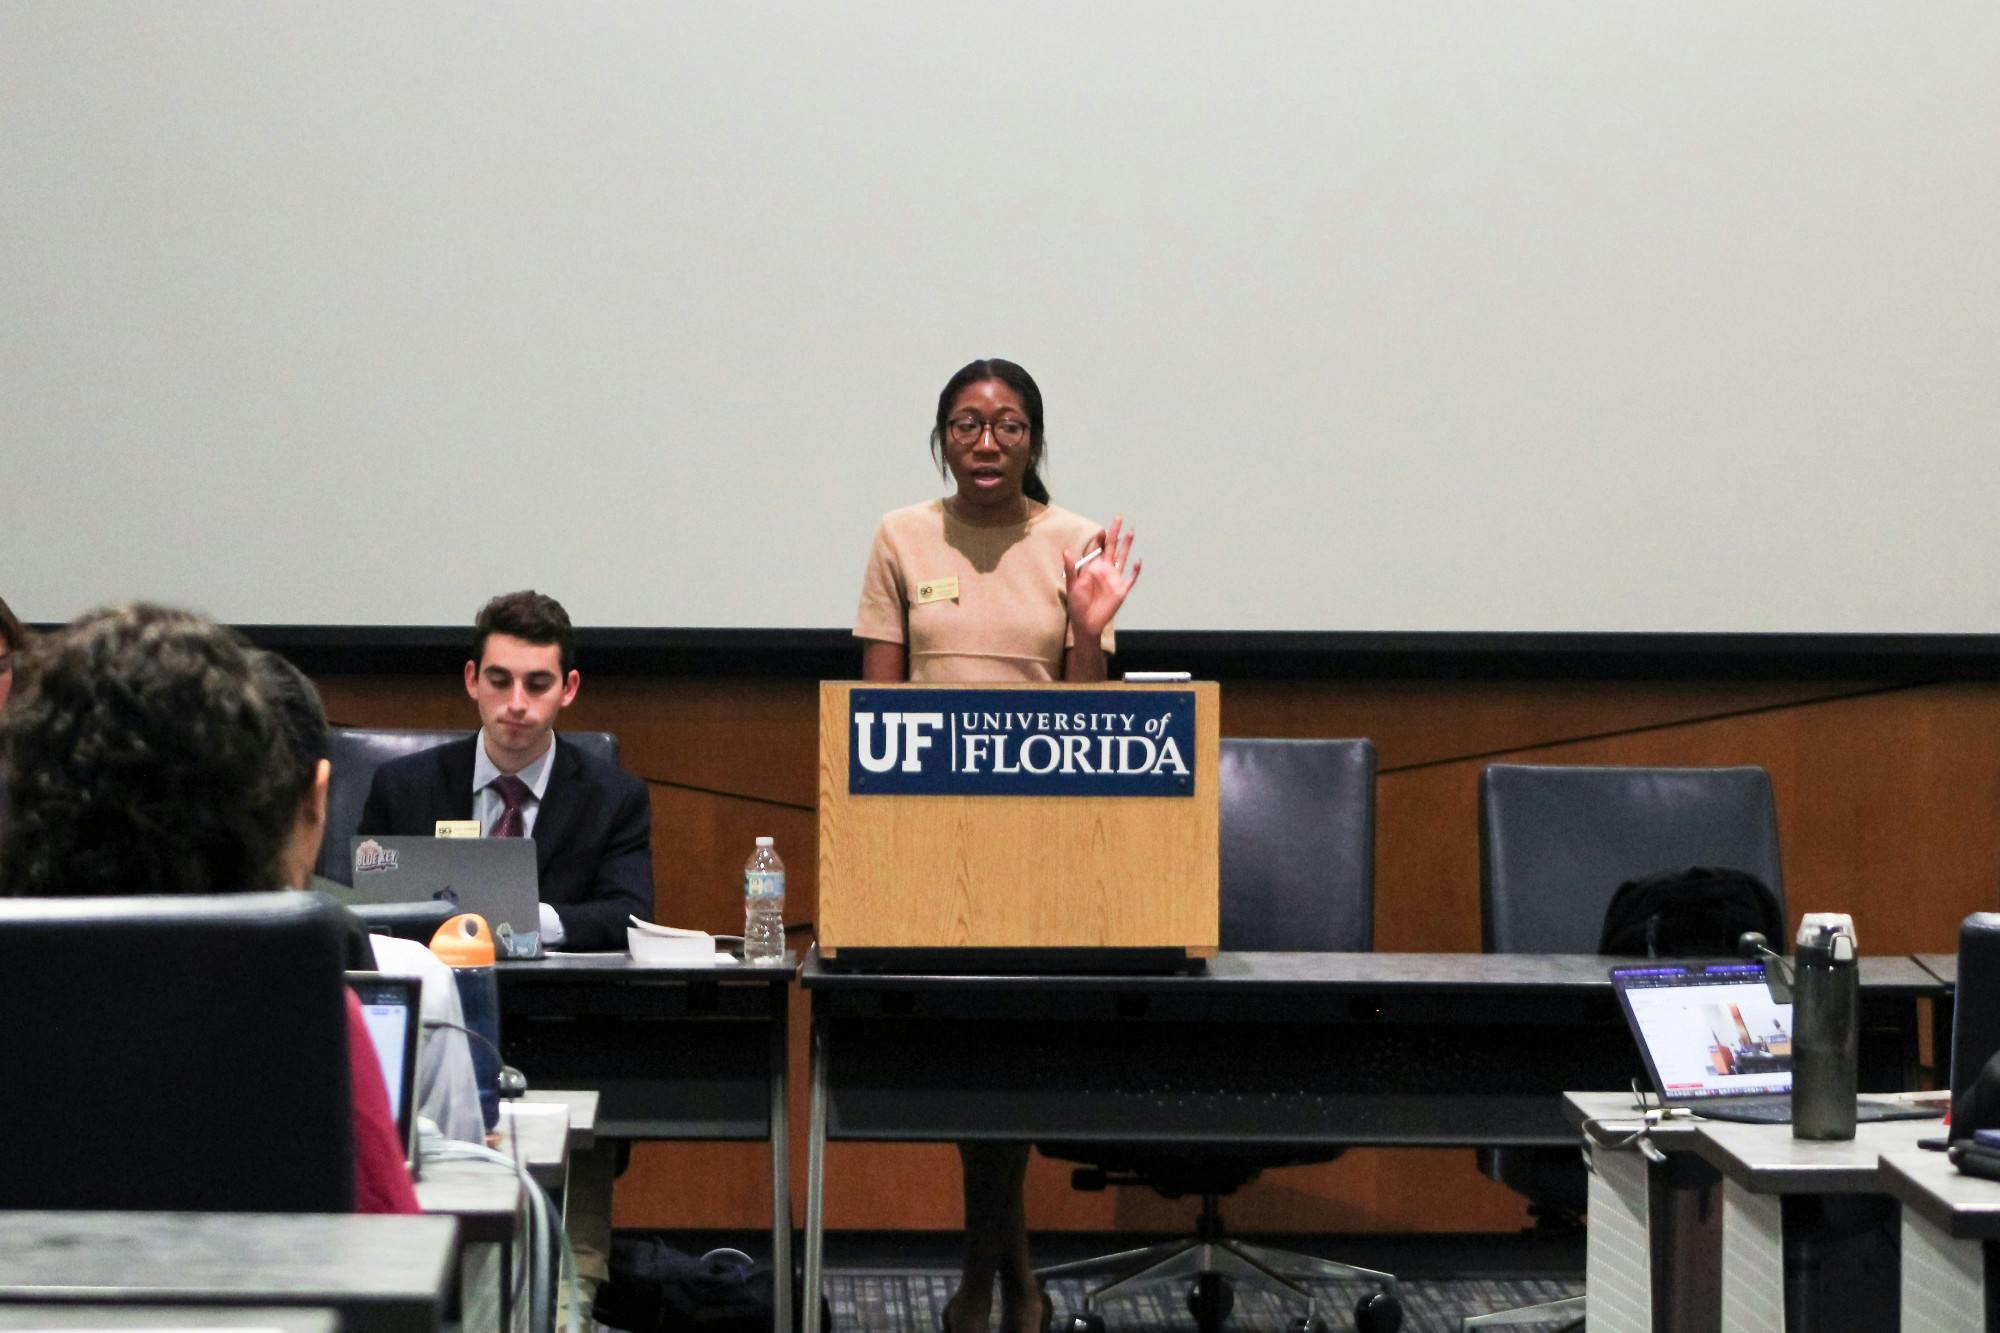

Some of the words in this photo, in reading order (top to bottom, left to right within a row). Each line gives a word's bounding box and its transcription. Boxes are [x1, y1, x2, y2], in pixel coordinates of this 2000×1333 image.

[855, 712, 943, 773] UF
[962, 712, 1135, 731] UNIVERSITY
[1144, 712, 1172, 740] of
[961, 734, 1190, 775] FLORIDA
[380, 850, 399, 864] KEY
